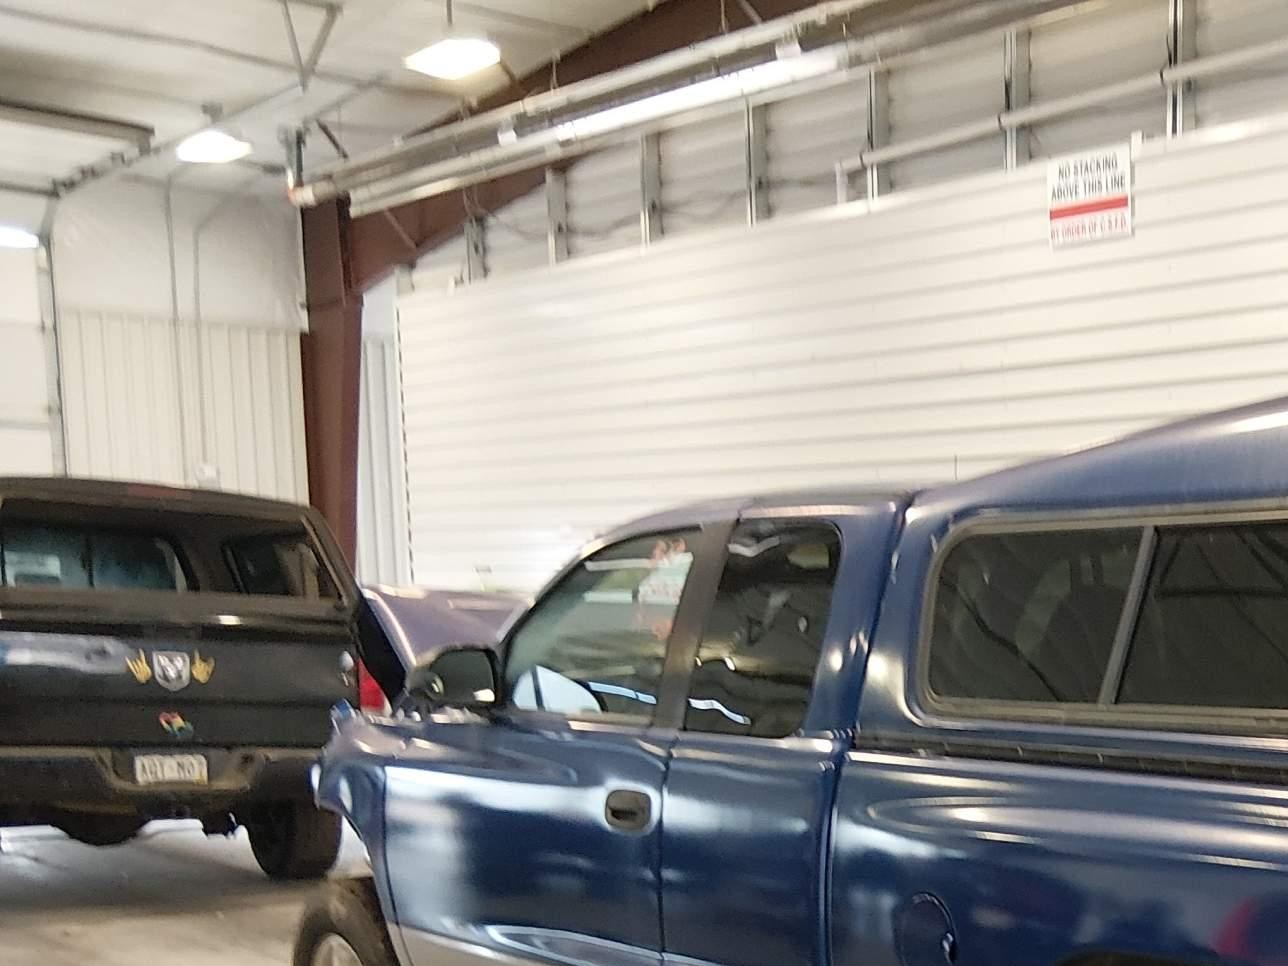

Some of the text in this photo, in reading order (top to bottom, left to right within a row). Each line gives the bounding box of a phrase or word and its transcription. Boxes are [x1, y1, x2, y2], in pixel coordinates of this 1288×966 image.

[1058, 154, 1118, 181] NO STACKING
[1051, 173, 1126, 200] ABOVE THIS LINE
